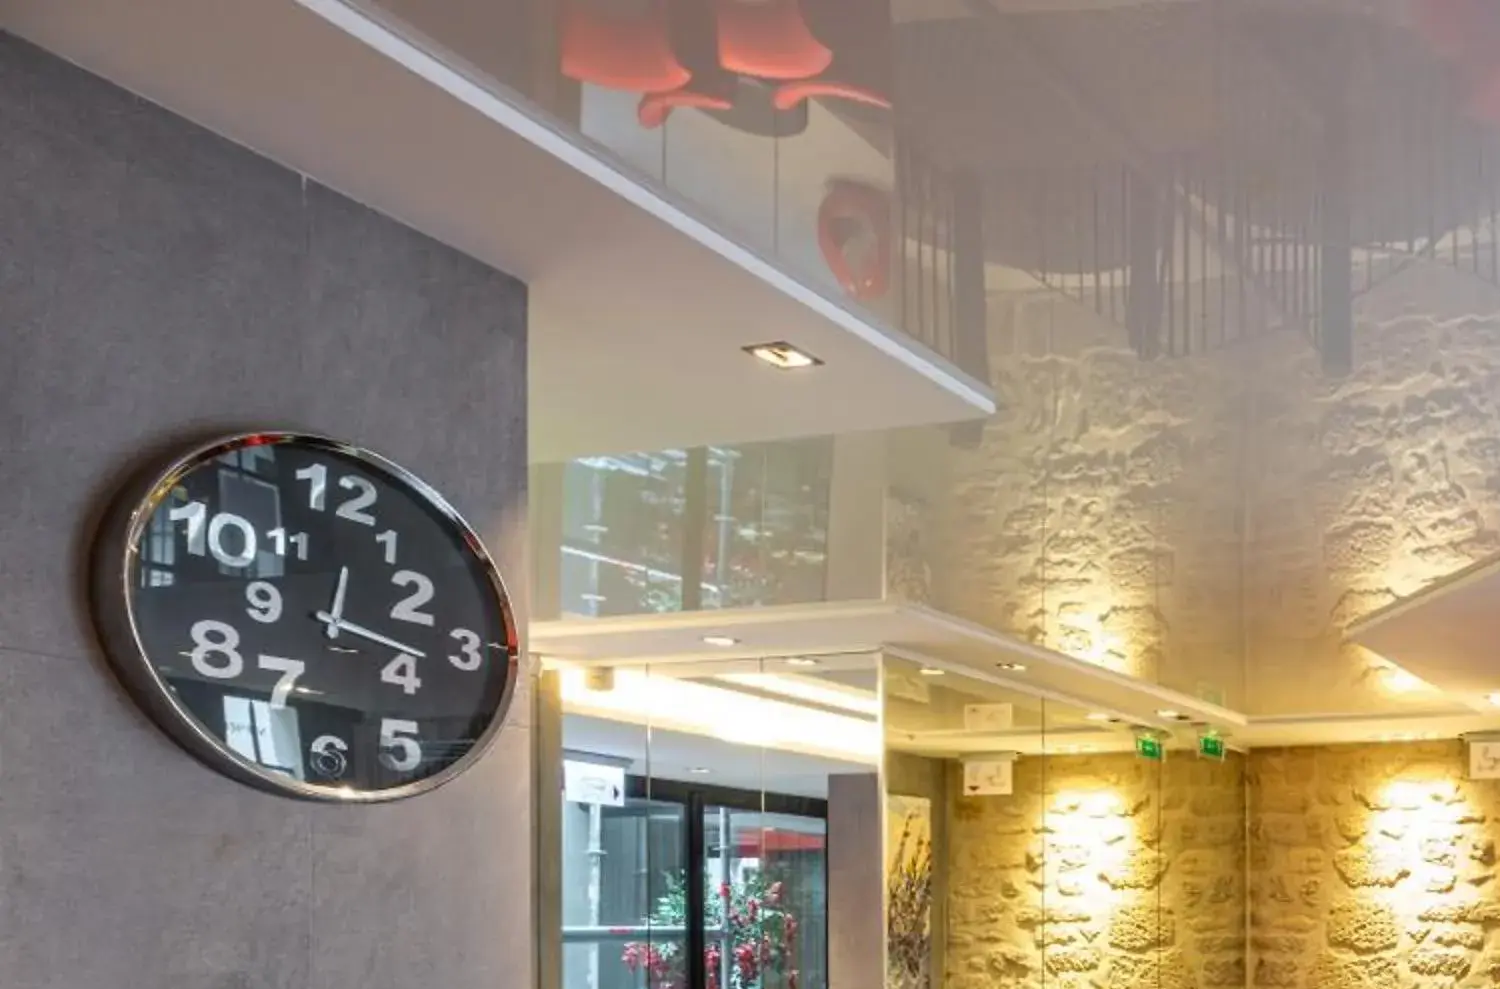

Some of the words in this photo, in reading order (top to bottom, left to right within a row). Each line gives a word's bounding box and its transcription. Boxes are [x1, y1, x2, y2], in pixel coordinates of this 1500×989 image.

[296, 463, 378, 527] 12
[169, 501, 257, 568] 10
[267, 527, 309, 561] 11
[375, 530, 397, 564] 1
[246, 581, 283, 624] 9
[389, 570, 435, 626] 2
[190, 620, 244, 679] 8
[448, 628, 481, 673] 3
[258, 655, 305, 710] 7
[380, 654, 422, 695] 4
[311, 735, 349, 777] 6
[378, 718, 422, 772] 5
